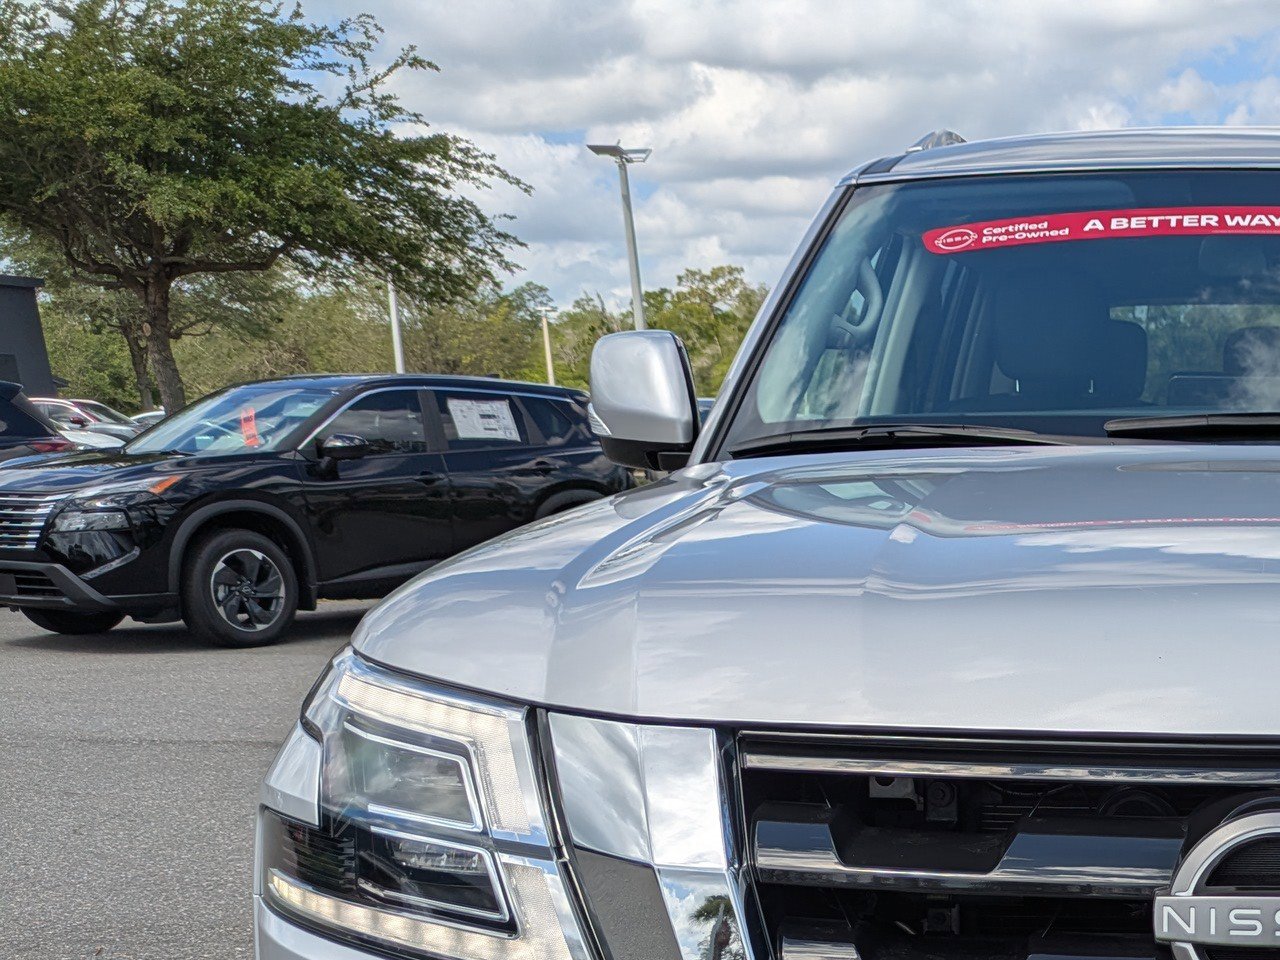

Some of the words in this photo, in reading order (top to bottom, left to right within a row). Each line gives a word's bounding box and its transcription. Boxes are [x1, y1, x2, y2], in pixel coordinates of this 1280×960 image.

[982, 221, 1049, 236] Certified
[1083, 218, 1105, 232] A
[1110, 214, 1219, 230] BETTER
[934, 231, 978, 247] NISSAN
[981, 227, 1070, 244] Pre-Owned
